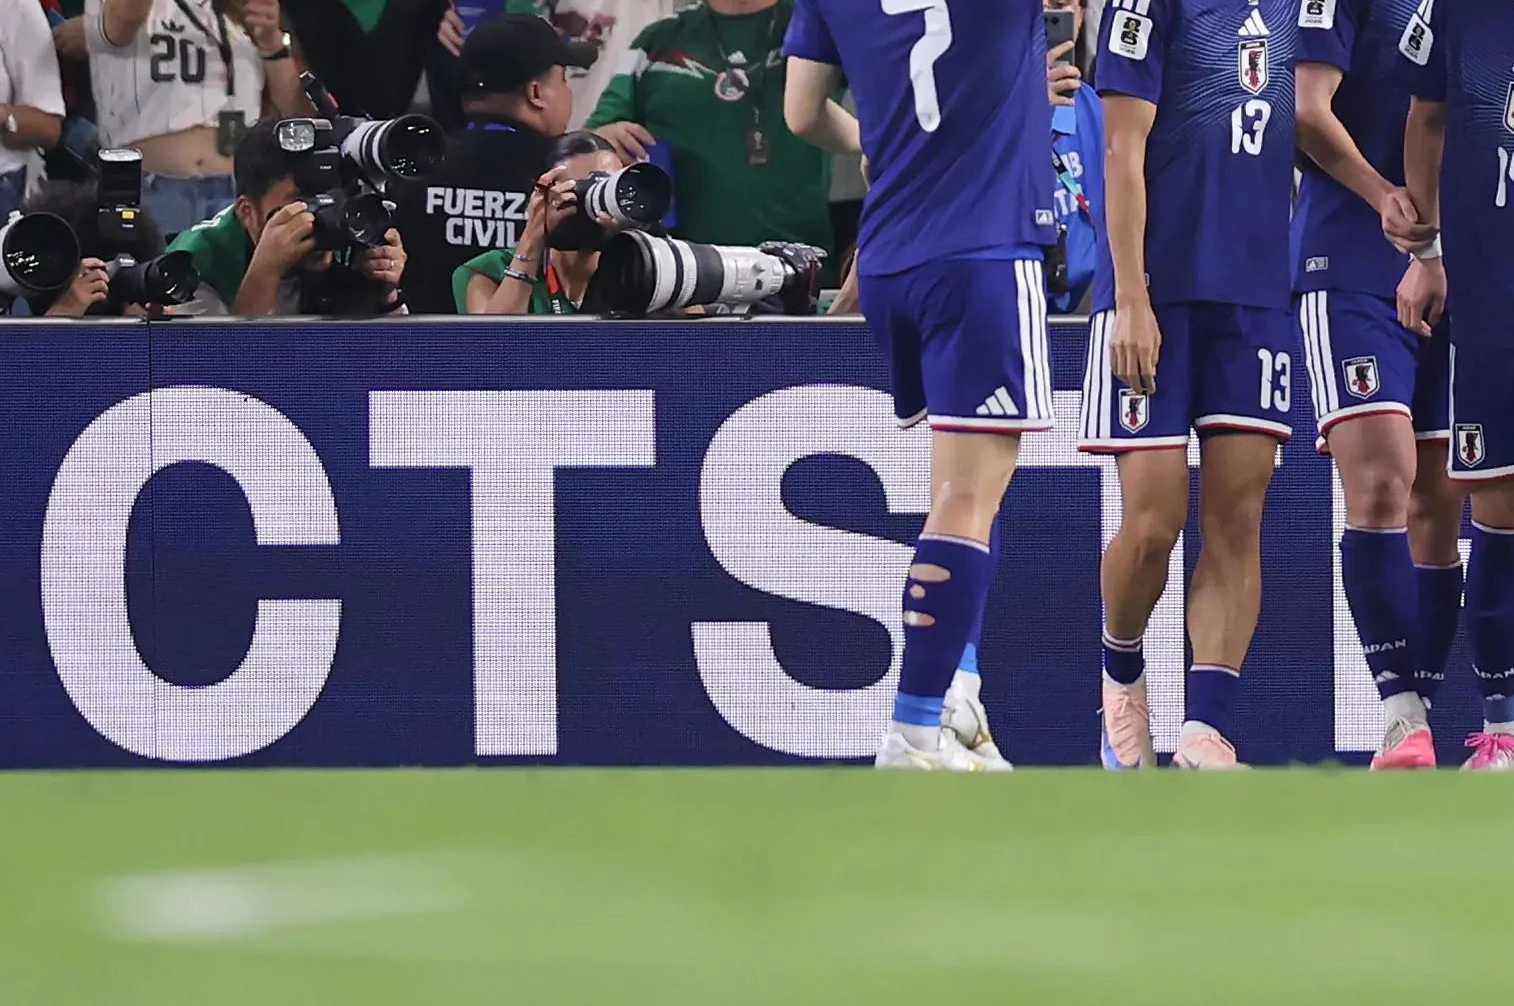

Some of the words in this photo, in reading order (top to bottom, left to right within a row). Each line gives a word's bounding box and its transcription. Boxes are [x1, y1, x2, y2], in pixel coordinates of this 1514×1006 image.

[150, 33, 206, 83] 20
[1231, 98, 1272, 156] 13
[426, 186, 529, 220] FUERZ
[446, 217, 520, 248] CIVIL
[1257, 348, 1291, 413] 13
